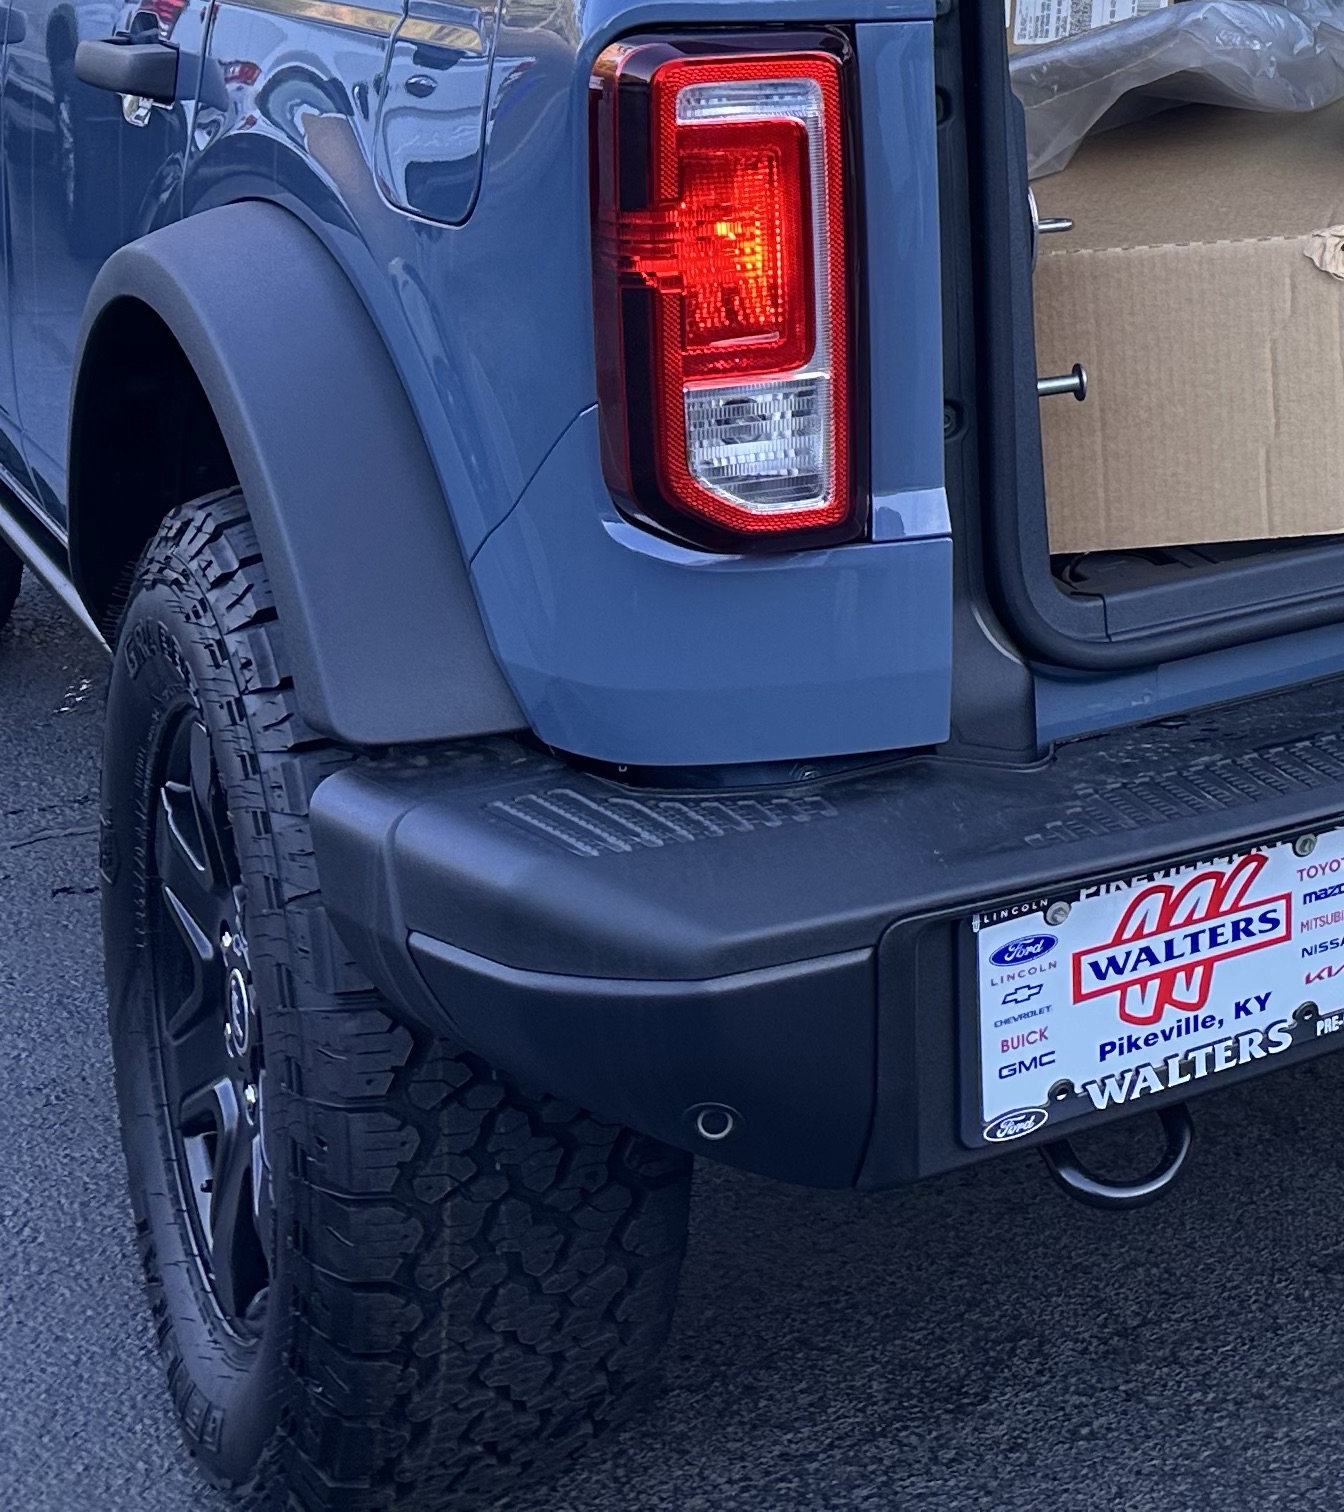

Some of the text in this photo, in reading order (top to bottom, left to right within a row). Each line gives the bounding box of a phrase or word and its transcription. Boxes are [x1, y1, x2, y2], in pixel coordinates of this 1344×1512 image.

[983, 899, 1049, 924] LINCOLN
[1087, 908, 1282, 981] WALTERS
[990, 960, 1057, 987] LINCOLN
[994, 1005, 1052, 1028] CHEVROLET
[1099, 991, 1273, 1063] Pikeville, KY
[1001, 1026, 1049, 1054] BUICK
[998, 1050, 1056, 1080] GMC
[1084, 1019, 1294, 1110] WALTERS
